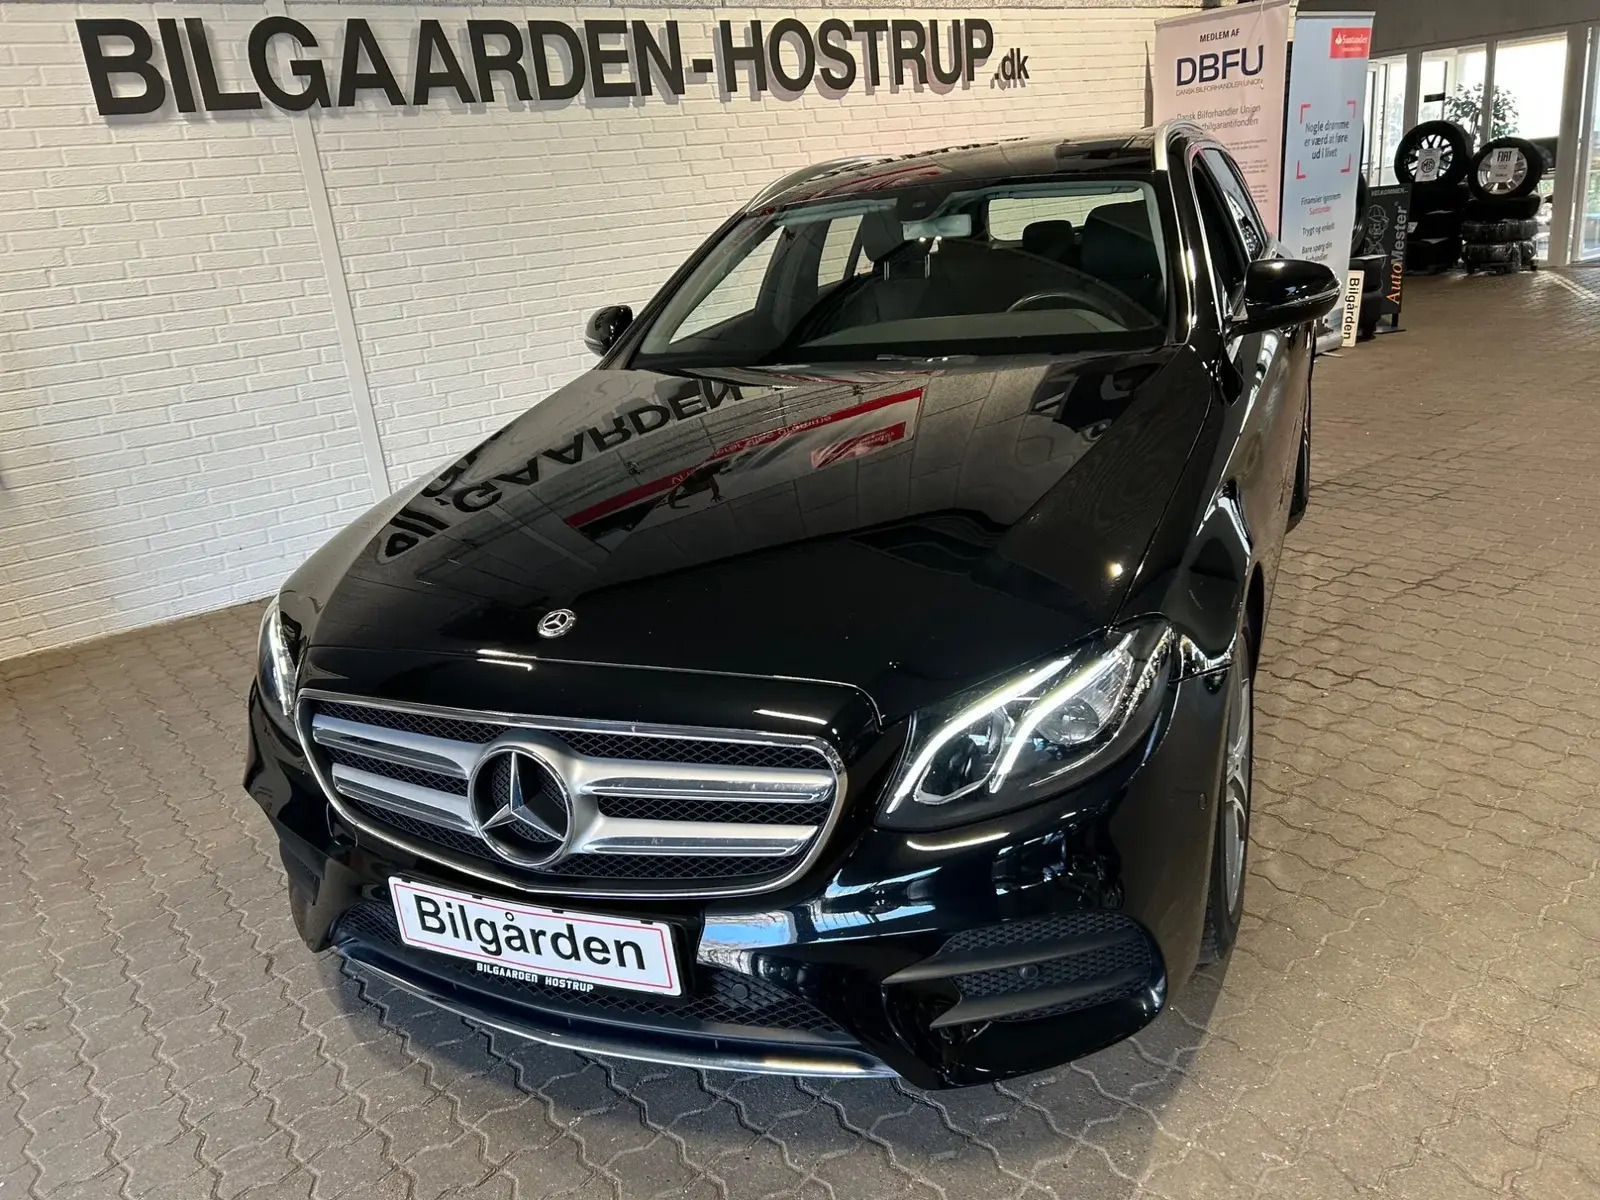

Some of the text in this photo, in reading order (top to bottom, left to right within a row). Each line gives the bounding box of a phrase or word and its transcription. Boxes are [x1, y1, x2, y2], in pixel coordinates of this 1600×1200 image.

[1199, 28, 1240, 43] MEDLEM AF
[1176, 44, 1264, 86] DBFU
[1175, 78, 1263, 96] DANSK BILFORHANDLER UNION
[1176, 104, 1261, 120] Dansk Bilforhandler Union
[1305, 119, 1350, 135] Nogle drømme
[1304, 139, 1311, 147] er
[1311, 133, 1328, 146] værd
[1336, 132, 1348, 143] føre
[1311, 148, 1321, 160] ud
[1325, 147, 1338, 158] livet
[1497, 151, 1512, 162] FIAT
[1302, 226, 1315, 236] Trygt
[1315, 226, 1321, 235] og
[1342, 277, 1361, 340] Bilgården
[413, 894, 646, 970] Bilgården
[476, 962, 594, 993] BILGAARDEN HOSTRUP
